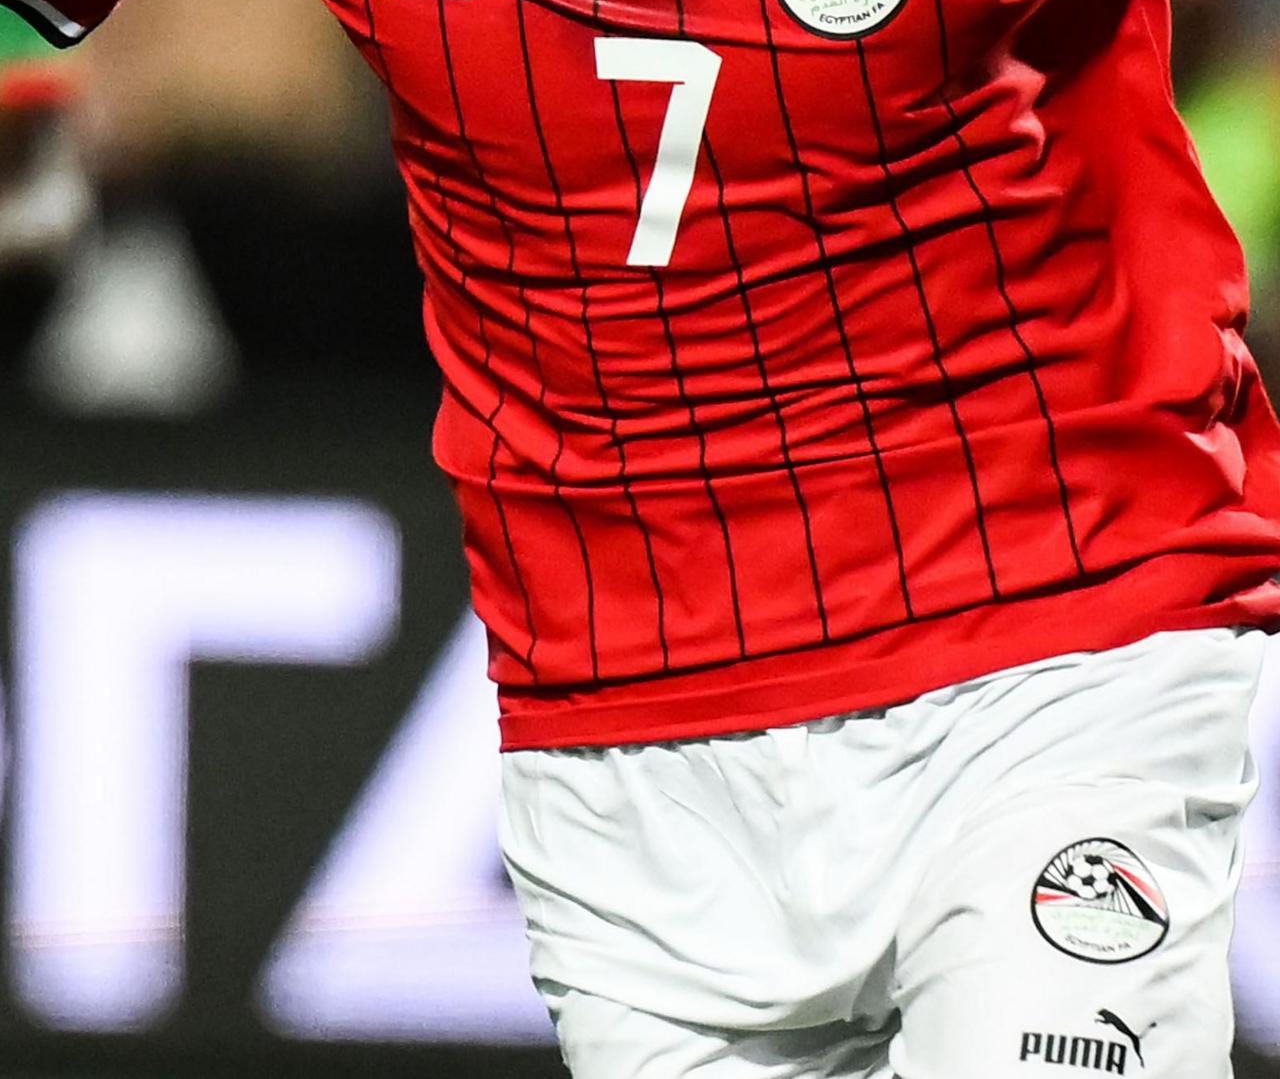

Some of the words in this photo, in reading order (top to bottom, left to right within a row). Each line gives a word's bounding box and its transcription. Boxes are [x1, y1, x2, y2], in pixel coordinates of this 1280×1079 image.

[819, 12, 871, 25] EGYPTIAN
[871, 2, 885, 14] FA
[593, 36, 723, 267] 7
[1019, 1032, 1127, 1076] PUMA
